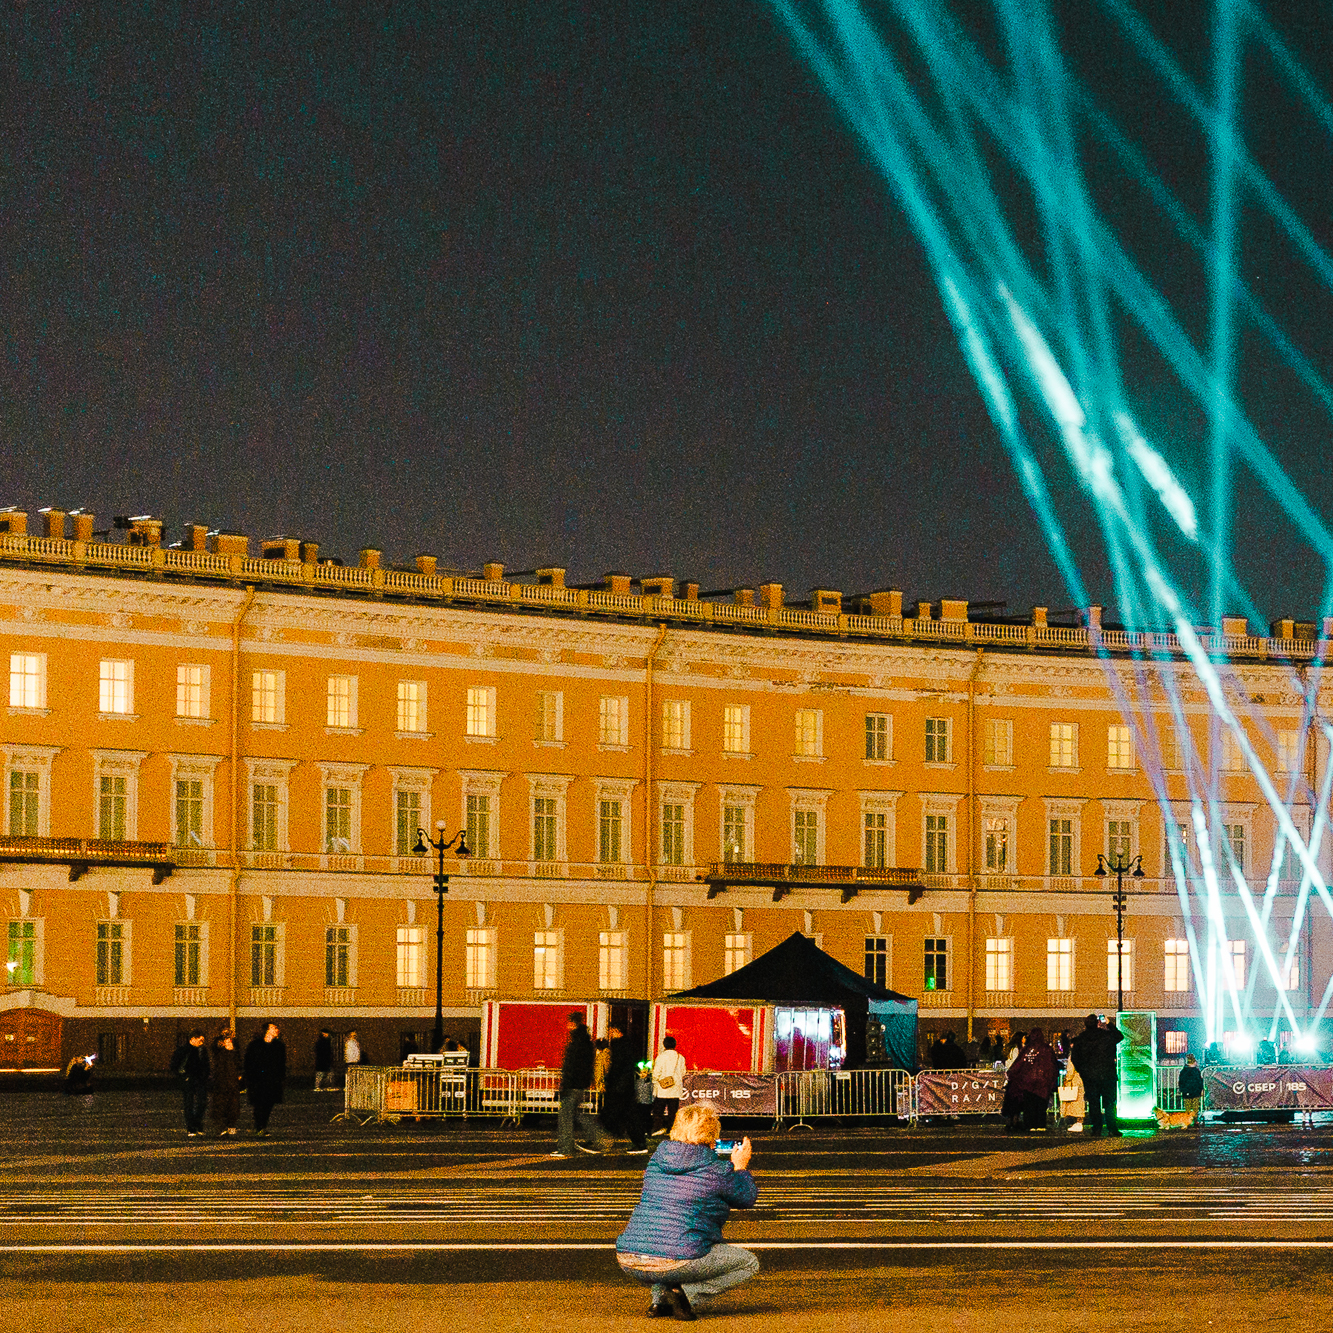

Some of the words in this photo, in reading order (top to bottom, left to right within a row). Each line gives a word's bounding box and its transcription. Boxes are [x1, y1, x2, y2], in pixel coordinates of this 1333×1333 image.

[951, 1080, 1008, 1090] D/G/T
[1247, 1082, 1276, 1092] СБЕР
[1285, 1082, 1307, 1091] 185
[691, 1089, 720, 1099] СБЕР
[730, 1089, 751, 1099] 185
